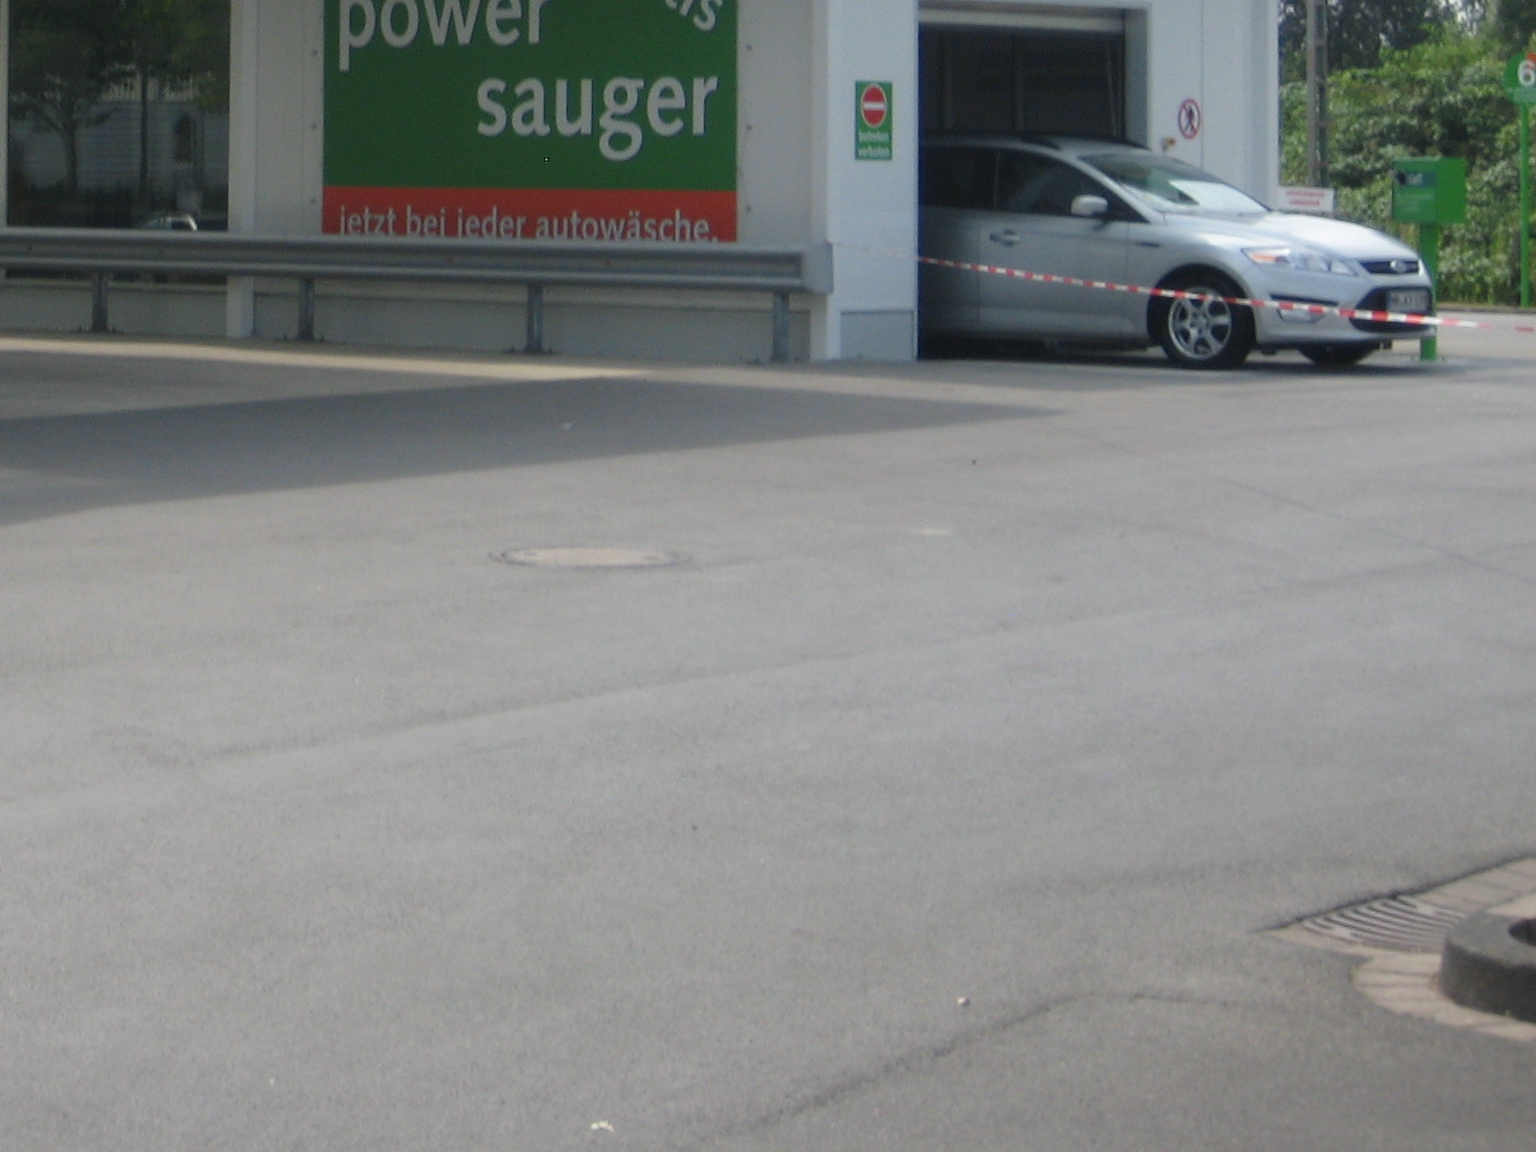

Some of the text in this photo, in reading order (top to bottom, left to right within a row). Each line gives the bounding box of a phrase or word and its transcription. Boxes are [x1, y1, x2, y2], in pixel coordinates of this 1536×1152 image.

[1517, 59, 1536, 88] 6
[476, 74, 719, 162] sauger
[406, 204, 446, 237] bei
